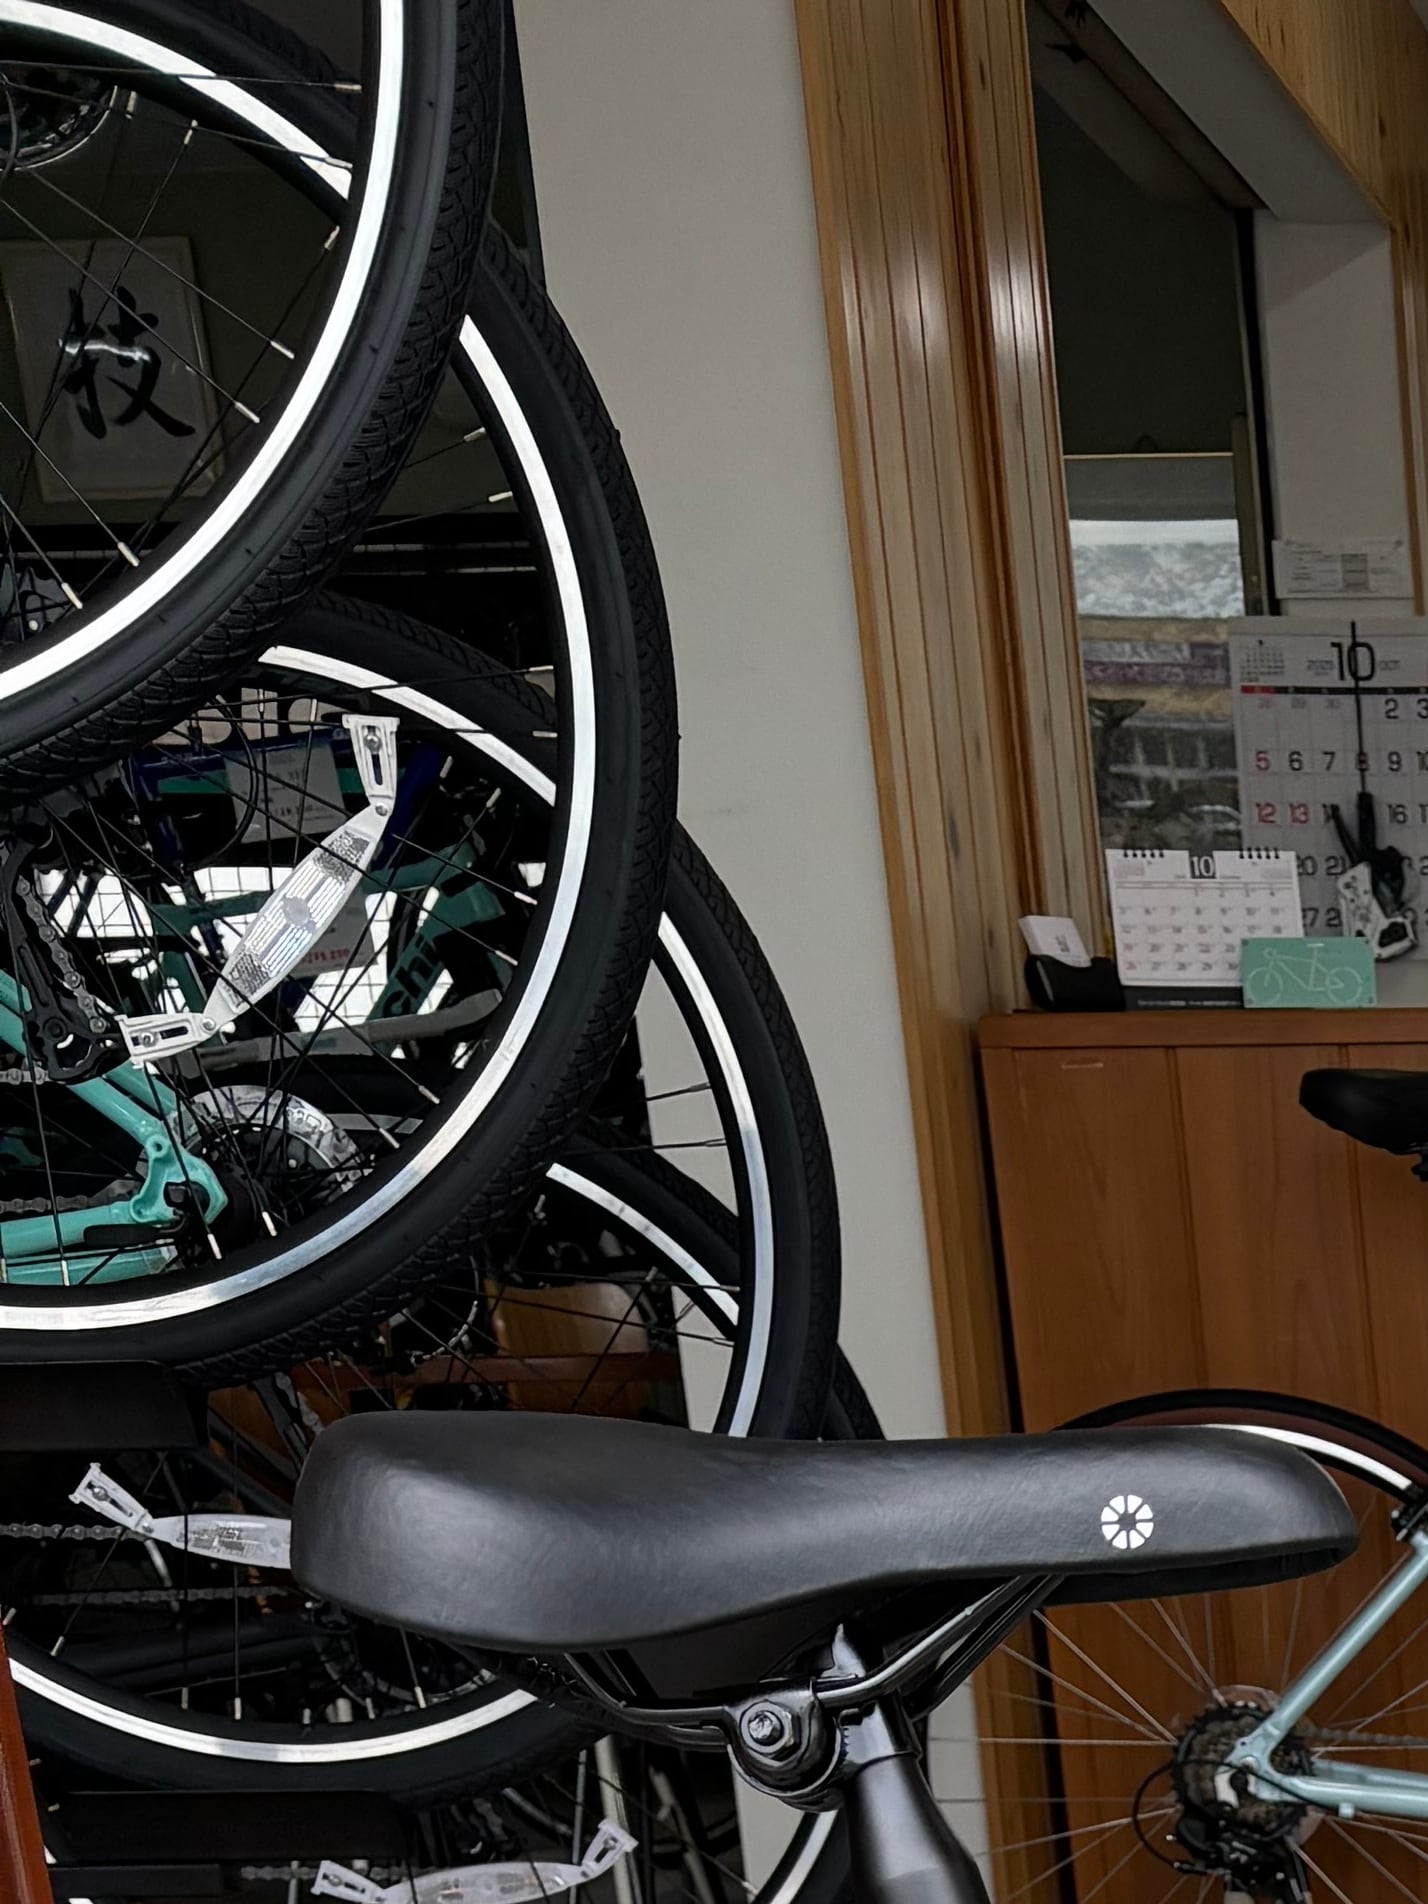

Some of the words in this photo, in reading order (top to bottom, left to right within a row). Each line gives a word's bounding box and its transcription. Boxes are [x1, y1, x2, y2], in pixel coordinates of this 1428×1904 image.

[1255, 751, 1270, 772] 5
[1288, 751, 1304, 772] 6
[1322, 751, 1336, 772] 7
[1387, 751, 1402, 772] 9
[1256, 803, 1277, 825] 12
[1289, 803, 1310, 825] 13
[1191, 856, 1215, 877] 10
